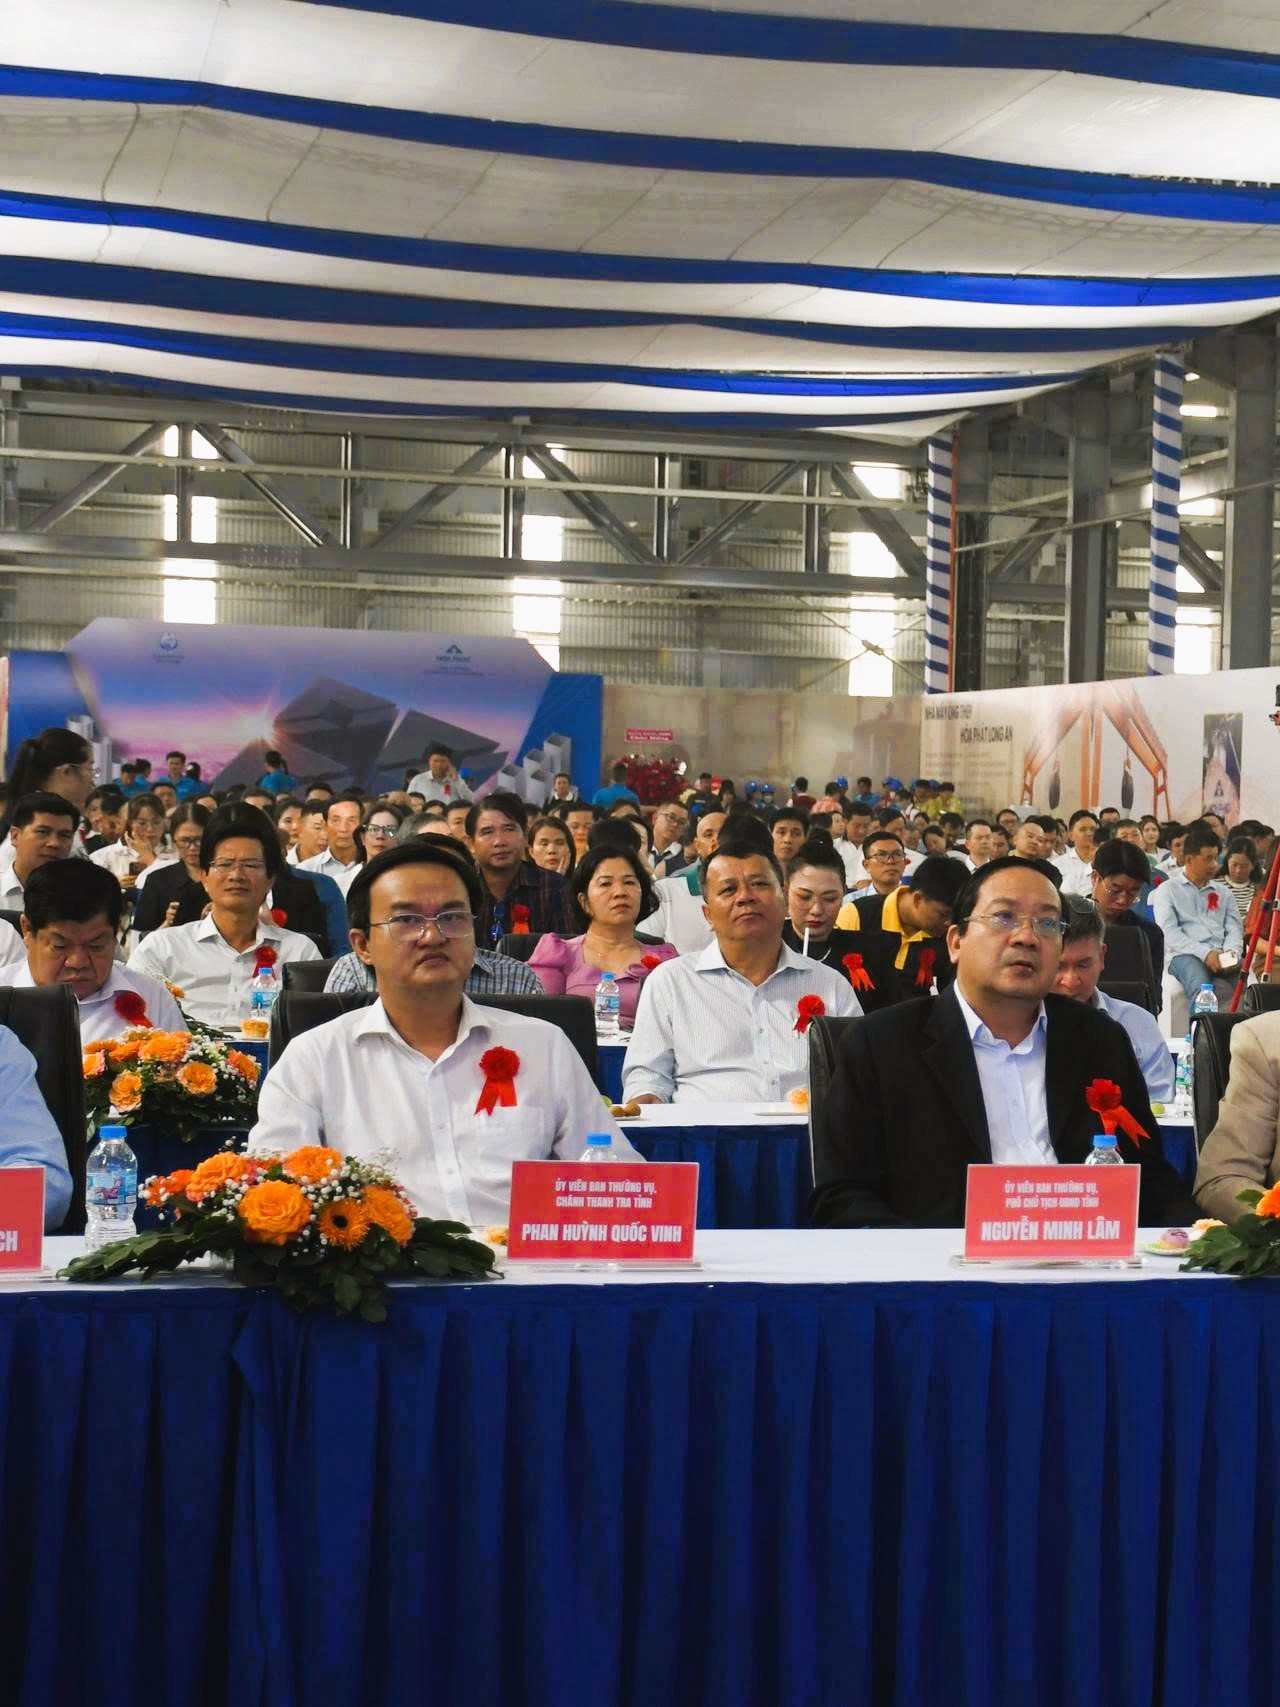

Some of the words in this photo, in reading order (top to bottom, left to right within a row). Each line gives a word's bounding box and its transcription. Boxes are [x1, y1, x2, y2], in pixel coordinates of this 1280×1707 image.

[555, 1178, 566, 1192] ỦY
[569, 1179, 587, 1192] VIÊN
[589, 1181, 605, 1193] BAN
[1017, 1180, 1034, 1193] VIÊN
[1036, 1183, 1051, 1193] BAN
[556, 1194, 584, 1207] CHÁNH
[587, 1197, 614, 1208] THANH
[616, 1197, 631, 1208] TRA
[633, 1194, 652, 1209] TỈNH
[522, 1223, 559, 1241] PHAN
[562, 1219, 608, 1241] HUỲNH
[611, 1220, 647, 1243] QUỐC
[651, 1225, 682, 1242] VINH
[981, 1215, 1039, 1241] NGUYỄN
[1043, 1220, 1083, 1240] MINH
[1087, 1215, 1120, 1240] LÂM
